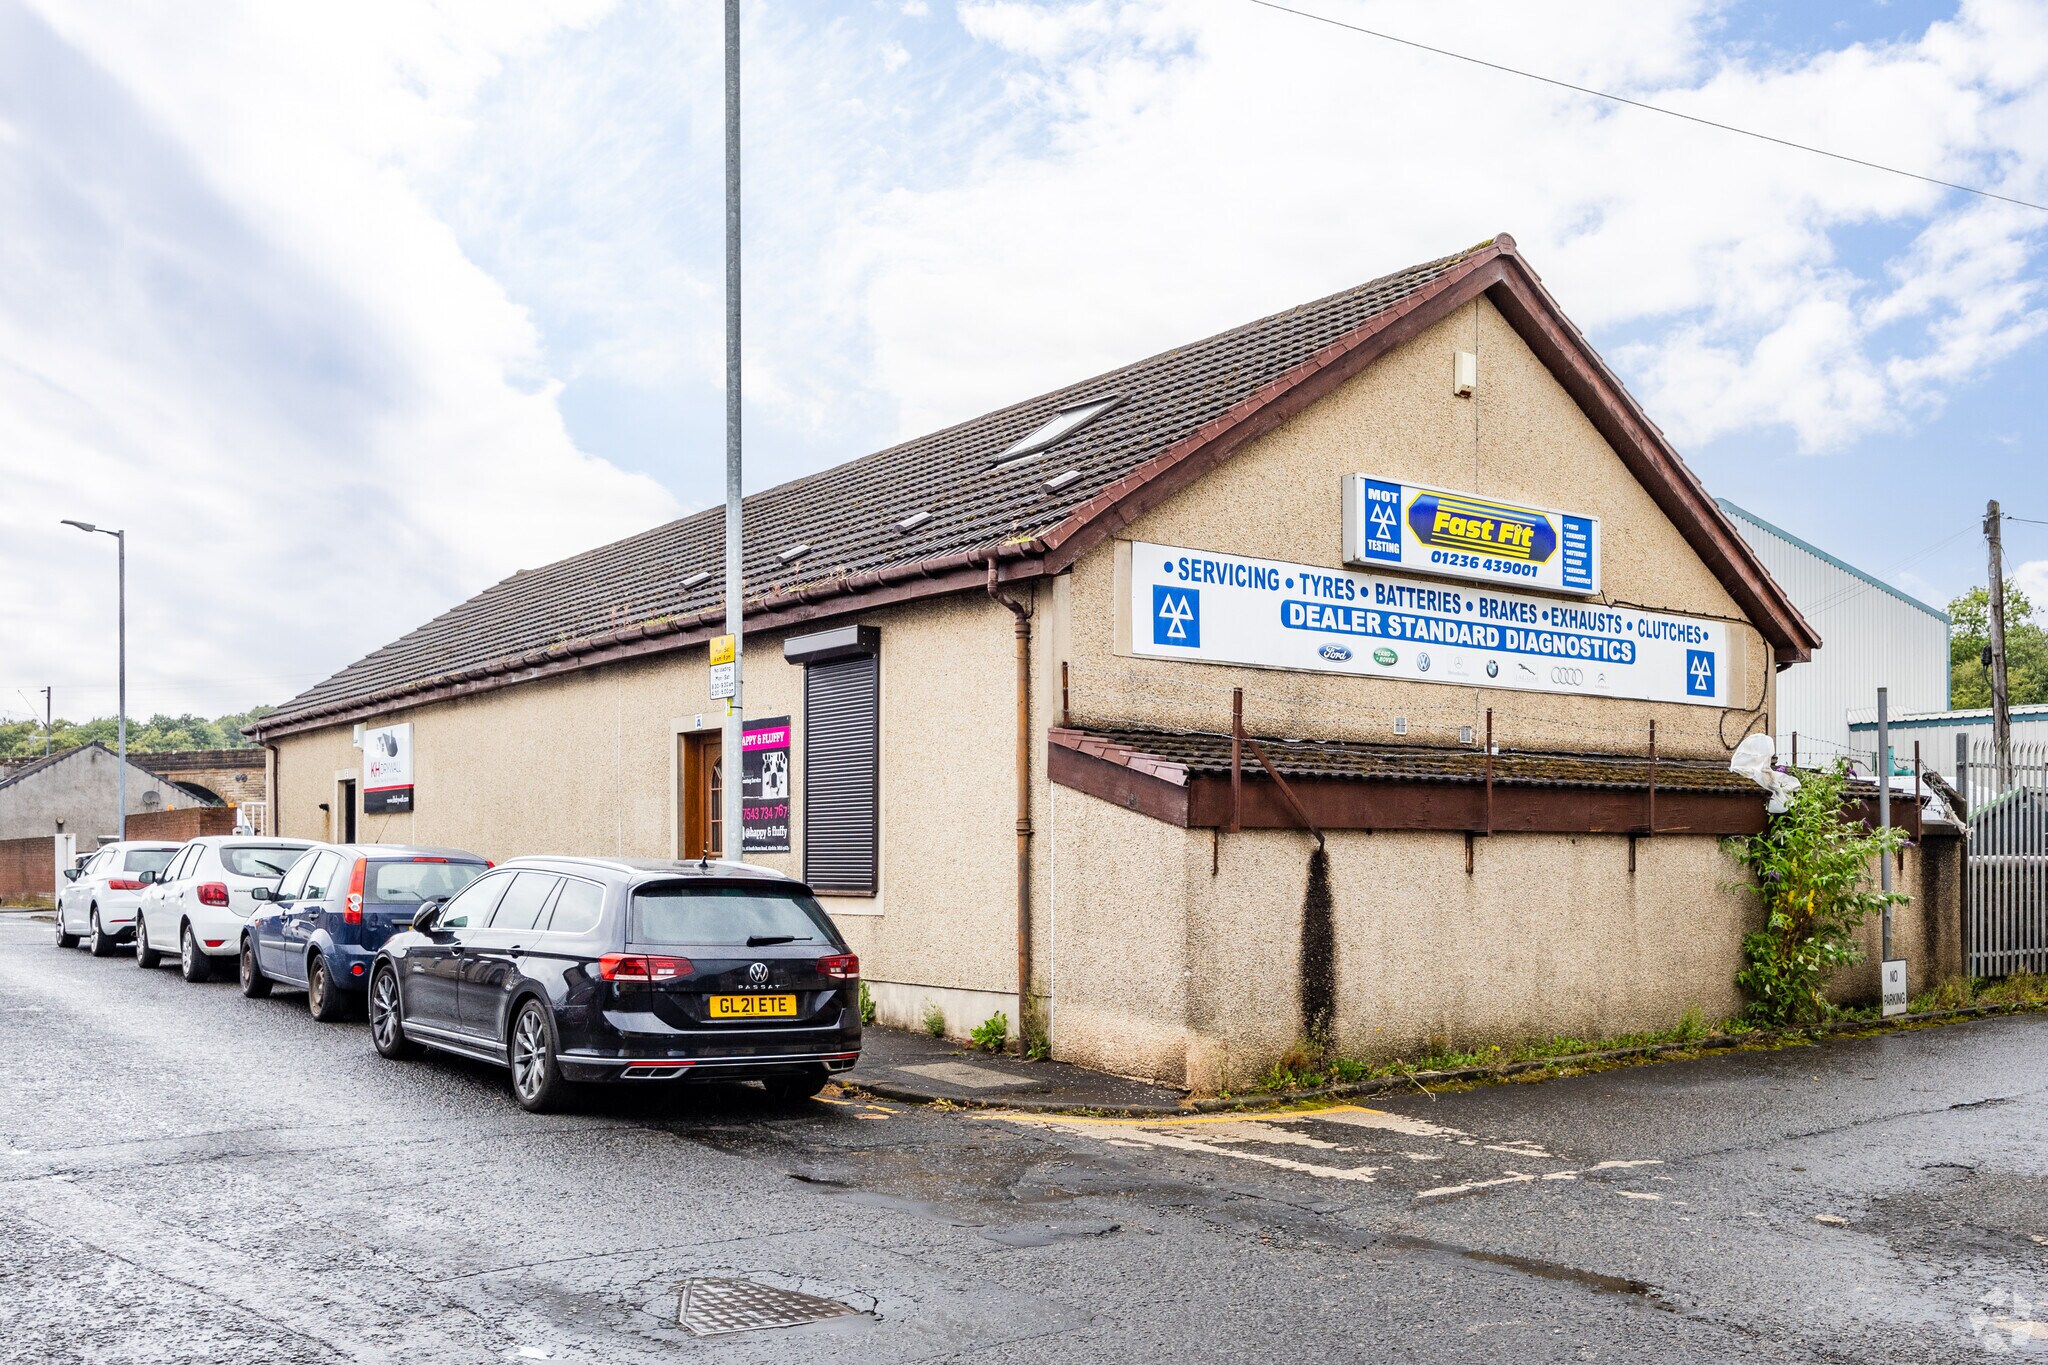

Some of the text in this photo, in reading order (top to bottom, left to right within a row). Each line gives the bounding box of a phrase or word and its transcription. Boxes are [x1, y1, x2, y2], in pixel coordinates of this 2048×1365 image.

[1367, 487, 1399, 504] MOT
[1432, 511, 1535, 547] Fast Fit
[1367, 538, 1400, 554] TESTING
[1431, 550, 1538, 578] 01236 439001
[1178, 557, 1701, 644] SERVICING TYRES BATTERIES BRAKES EXHAUSTS CLUTCHES
[1289, 603, 1632, 662] DEALER STANDARD DIAGNOSTICS
[1324, 646, 1347, 660] Ford
[742, 731, 785, 746] APPY & FLUFFY
[760, 807, 773, 820] 734
[774, 803, 788, 819] 767
[746, 825, 788, 839] @happy & fluffy
[1889, 970, 1899, 983] NO
[720, 997, 787, 1013] GL21 ETE
[1884, 991, 1906, 1007] PARKING
